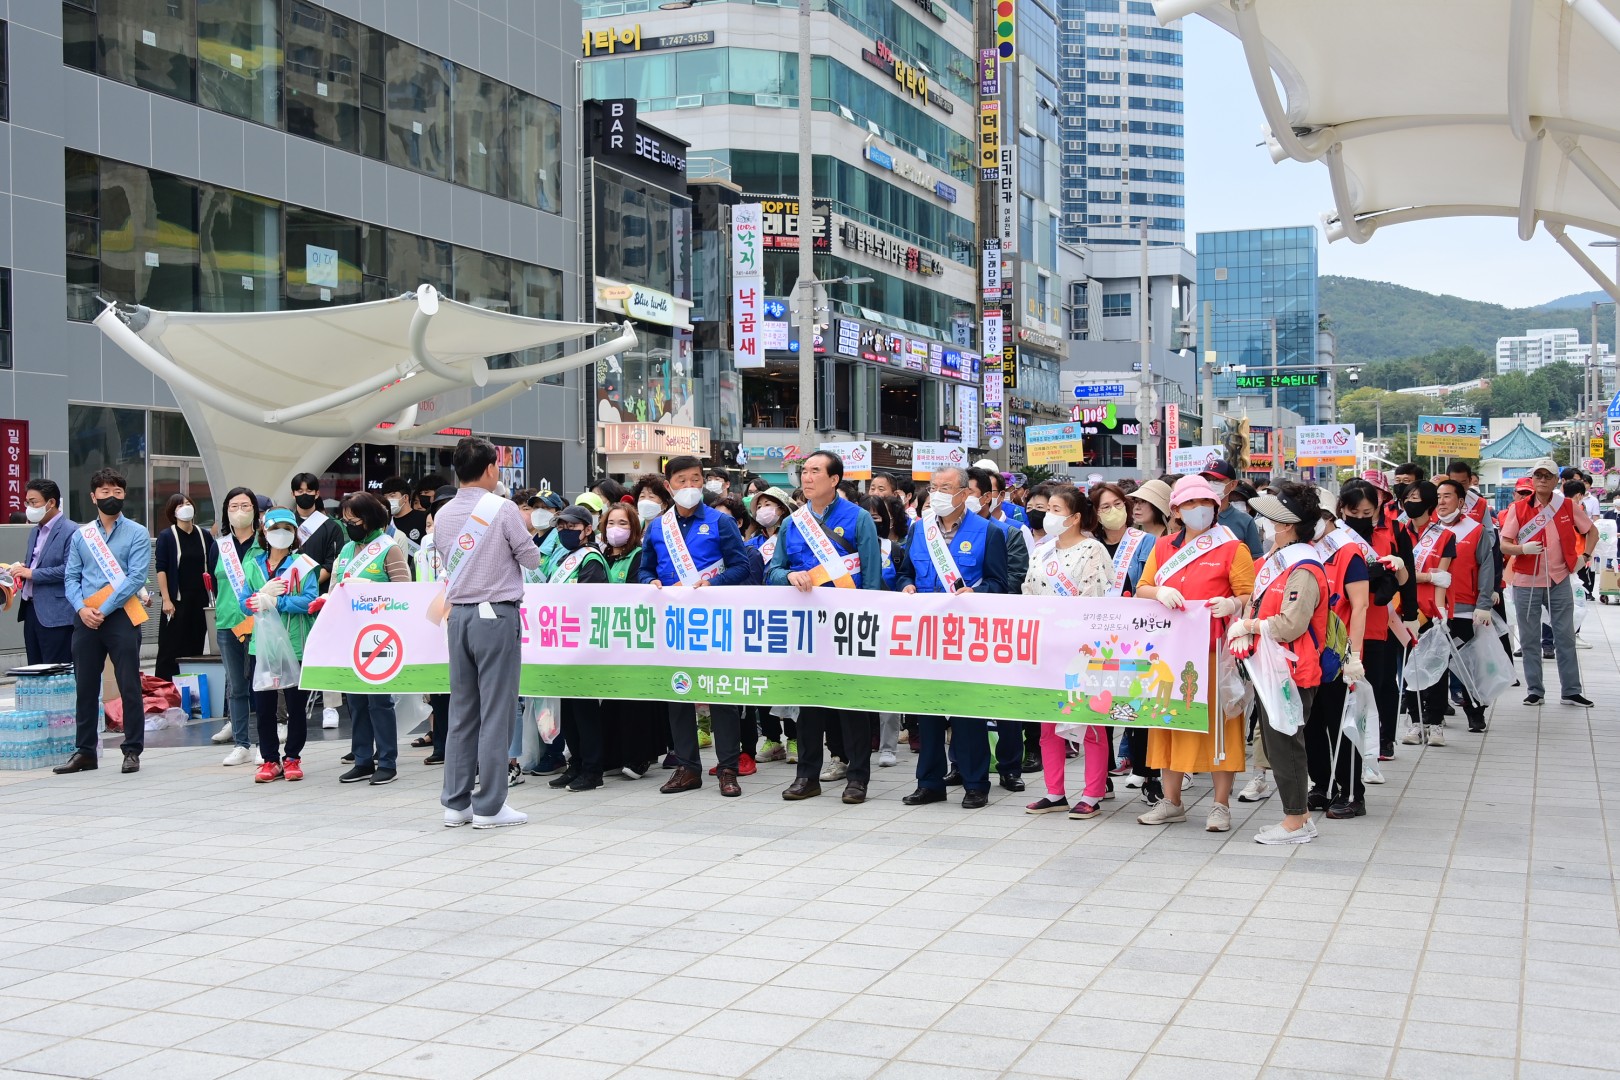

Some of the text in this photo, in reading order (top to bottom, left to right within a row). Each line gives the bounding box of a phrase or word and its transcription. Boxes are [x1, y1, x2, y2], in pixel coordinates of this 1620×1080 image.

[660, 32, 708, 46] T.747-3153
[896, 60, 928, 106] 더타이
[610, 104, 624, 148] BAR
[983, 114, 998, 164] 더타이
[636, 134, 686, 171] BEE BAR 3F
[1002, 150, 1012, 204] 티키타카
[760, 201, 799, 214] TOP TE
[988, 251, 996, 286] 노래타운
[634, 292, 667, 312] Blue turtle
[739, 288, 756, 355] 낙곱새
[1003, 347, 1015, 387] 궁타이
[1458, 425, 1476, 434] 꽁초
[8, 429, 21, 514] 밀양돼지국
[931, 540, 950, 572] 담배꽁초
[1162, 546, 1195, 576] 담배꽁초
[538, 606, 580, 648] 없는
[589, 604, 656, 649] 쾌적한
[665, 605, 732, 652] 해운대
[744, 609, 826, 654] 만들기”
[834, 611, 880, 657] 위한
[890, 613, 1040, 665] 도시환경정비
[698, 674, 768, 695] 해운대구
